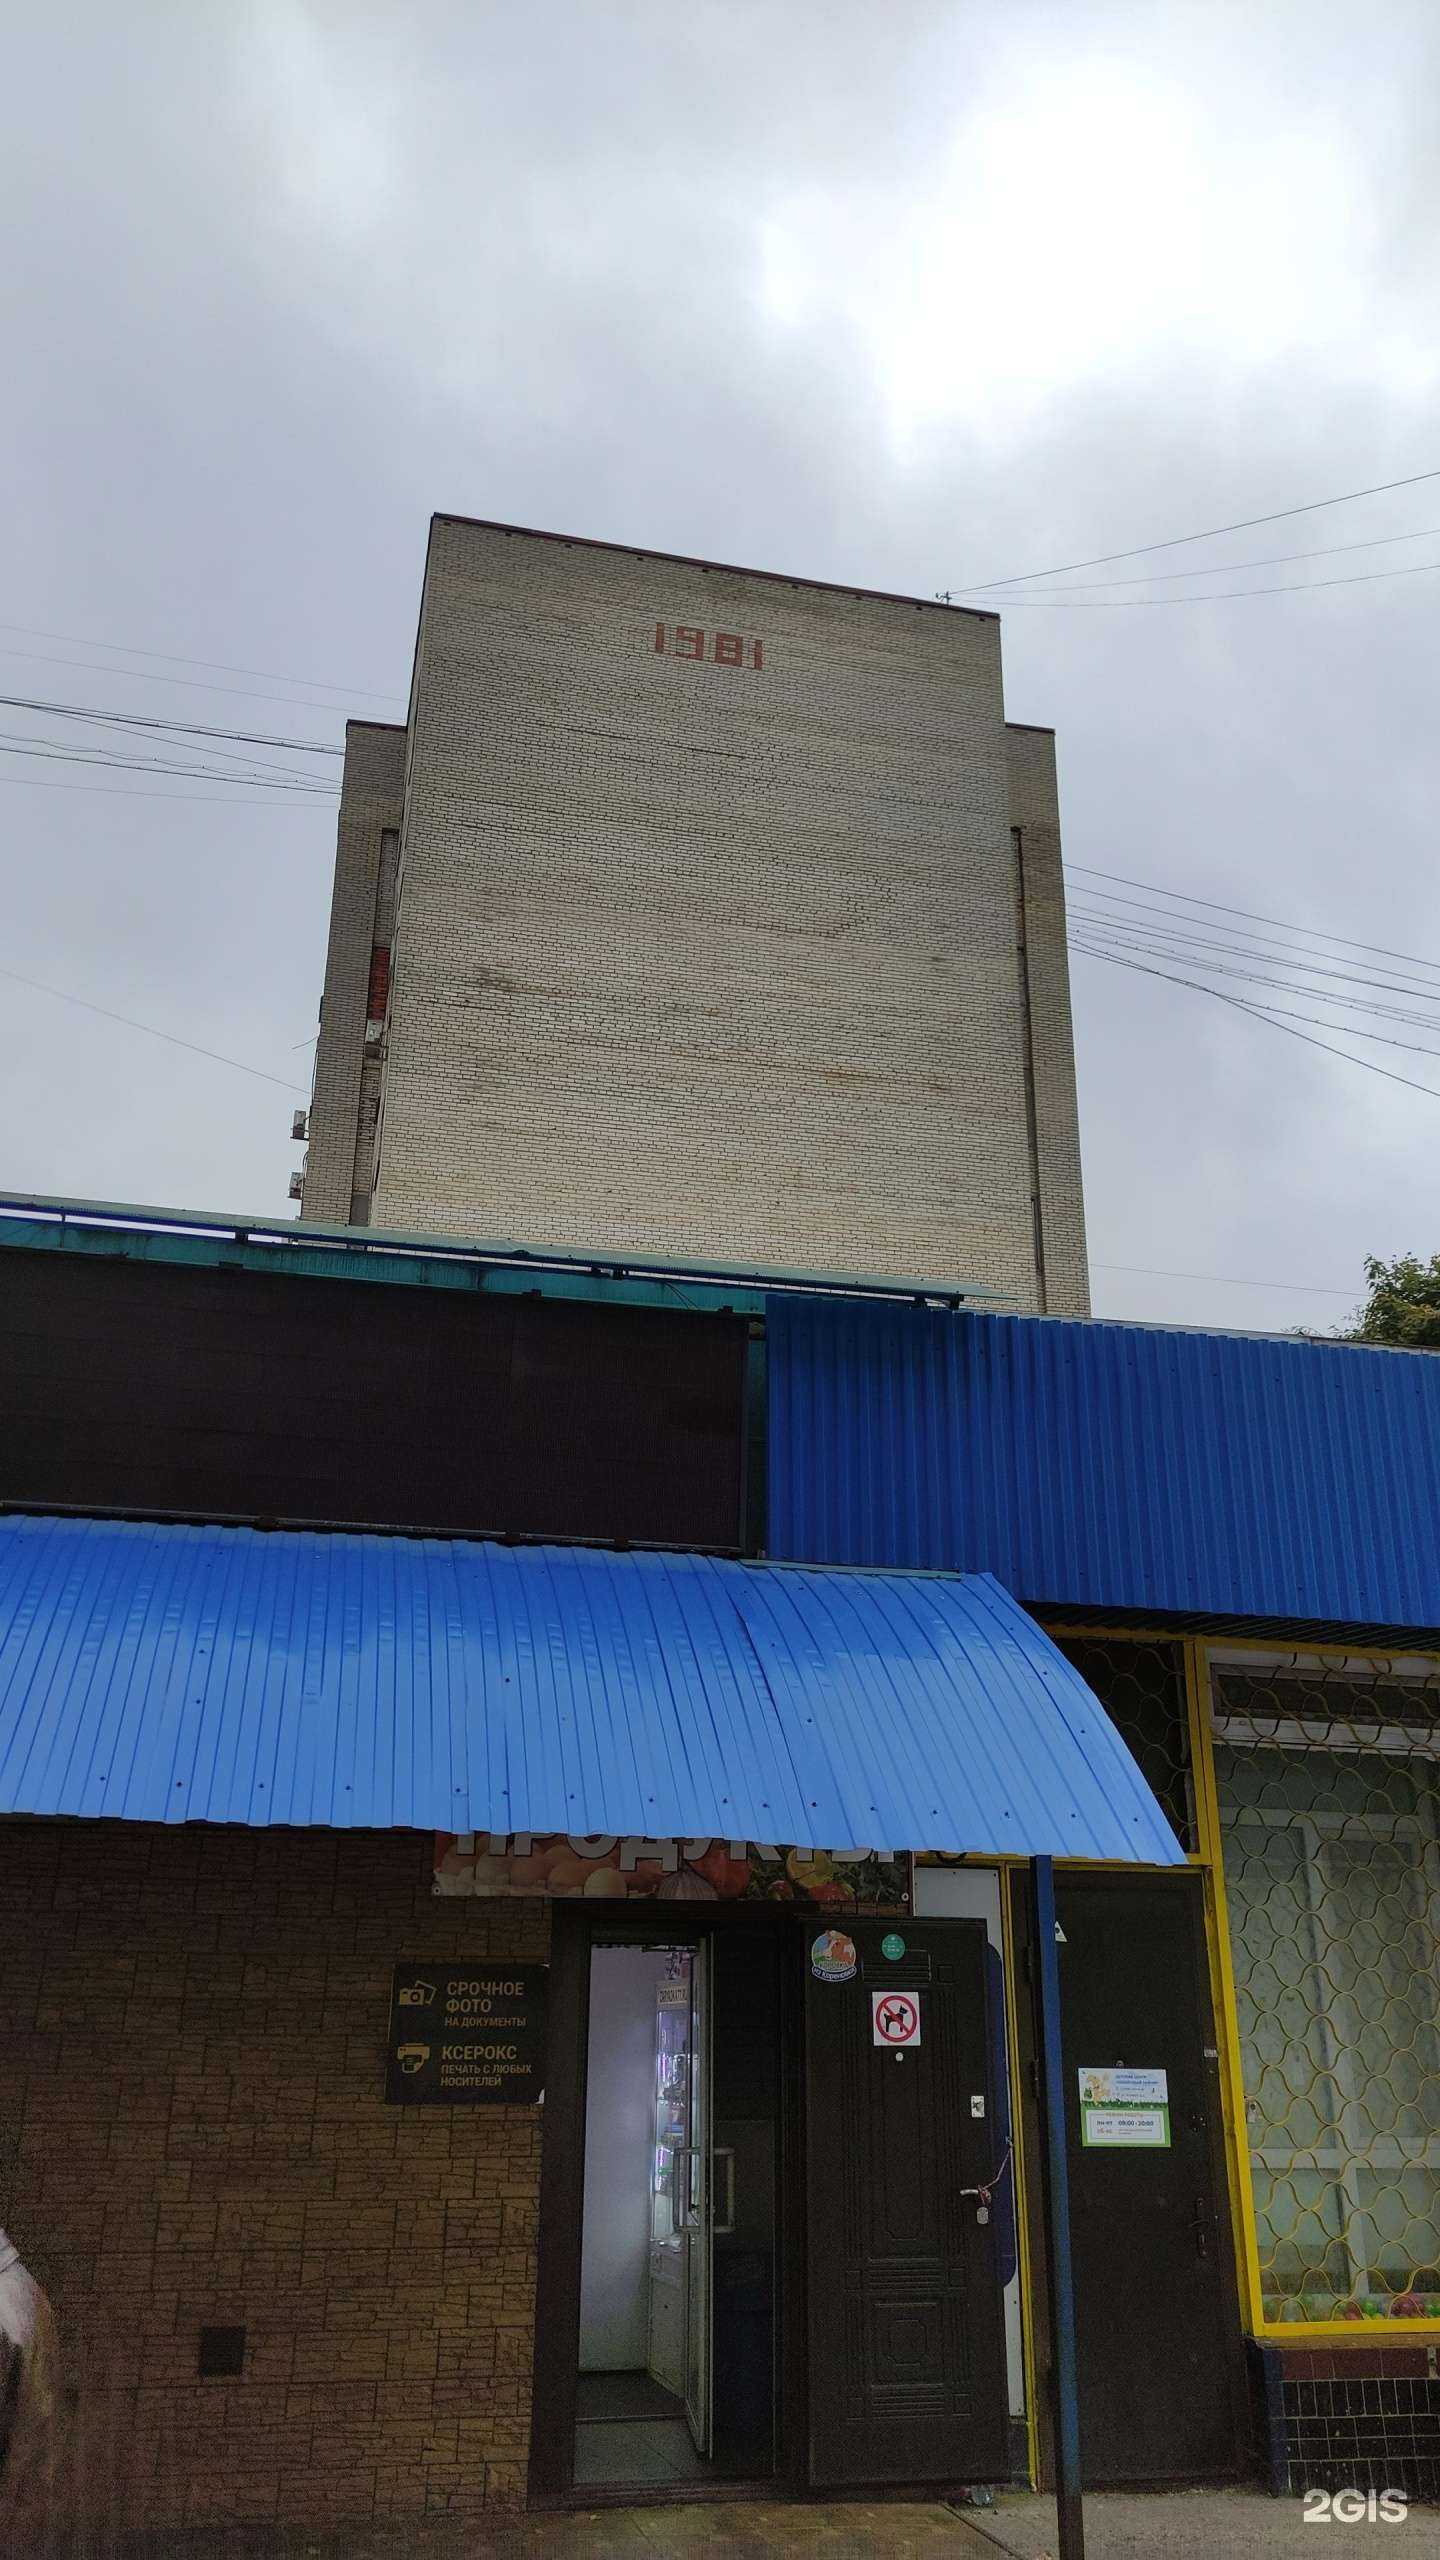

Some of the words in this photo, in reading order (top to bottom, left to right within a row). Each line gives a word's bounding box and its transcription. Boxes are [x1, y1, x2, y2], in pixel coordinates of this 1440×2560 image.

[655, 623, 763, 670] 1981
[447, 1982, 525, 1996] СРОЧНОЕ
[446, 1998, 492, 2013] ФОТО
[444, 2017, 459, 2026] НА
[461, 2017, 527, 2028] ДОКУМЕНТЫ
[441, 2046, 517, 2060] КСЕРОКС
[440, 2064, 481, 2075] ПЕЧАТЬ
[483, 2064, 490, 2074] С
[493, 2064, 533, 2075] ЛЮБЫХ
[440, 2075, 502, 2087] НОСИТЕЛЕЙ
